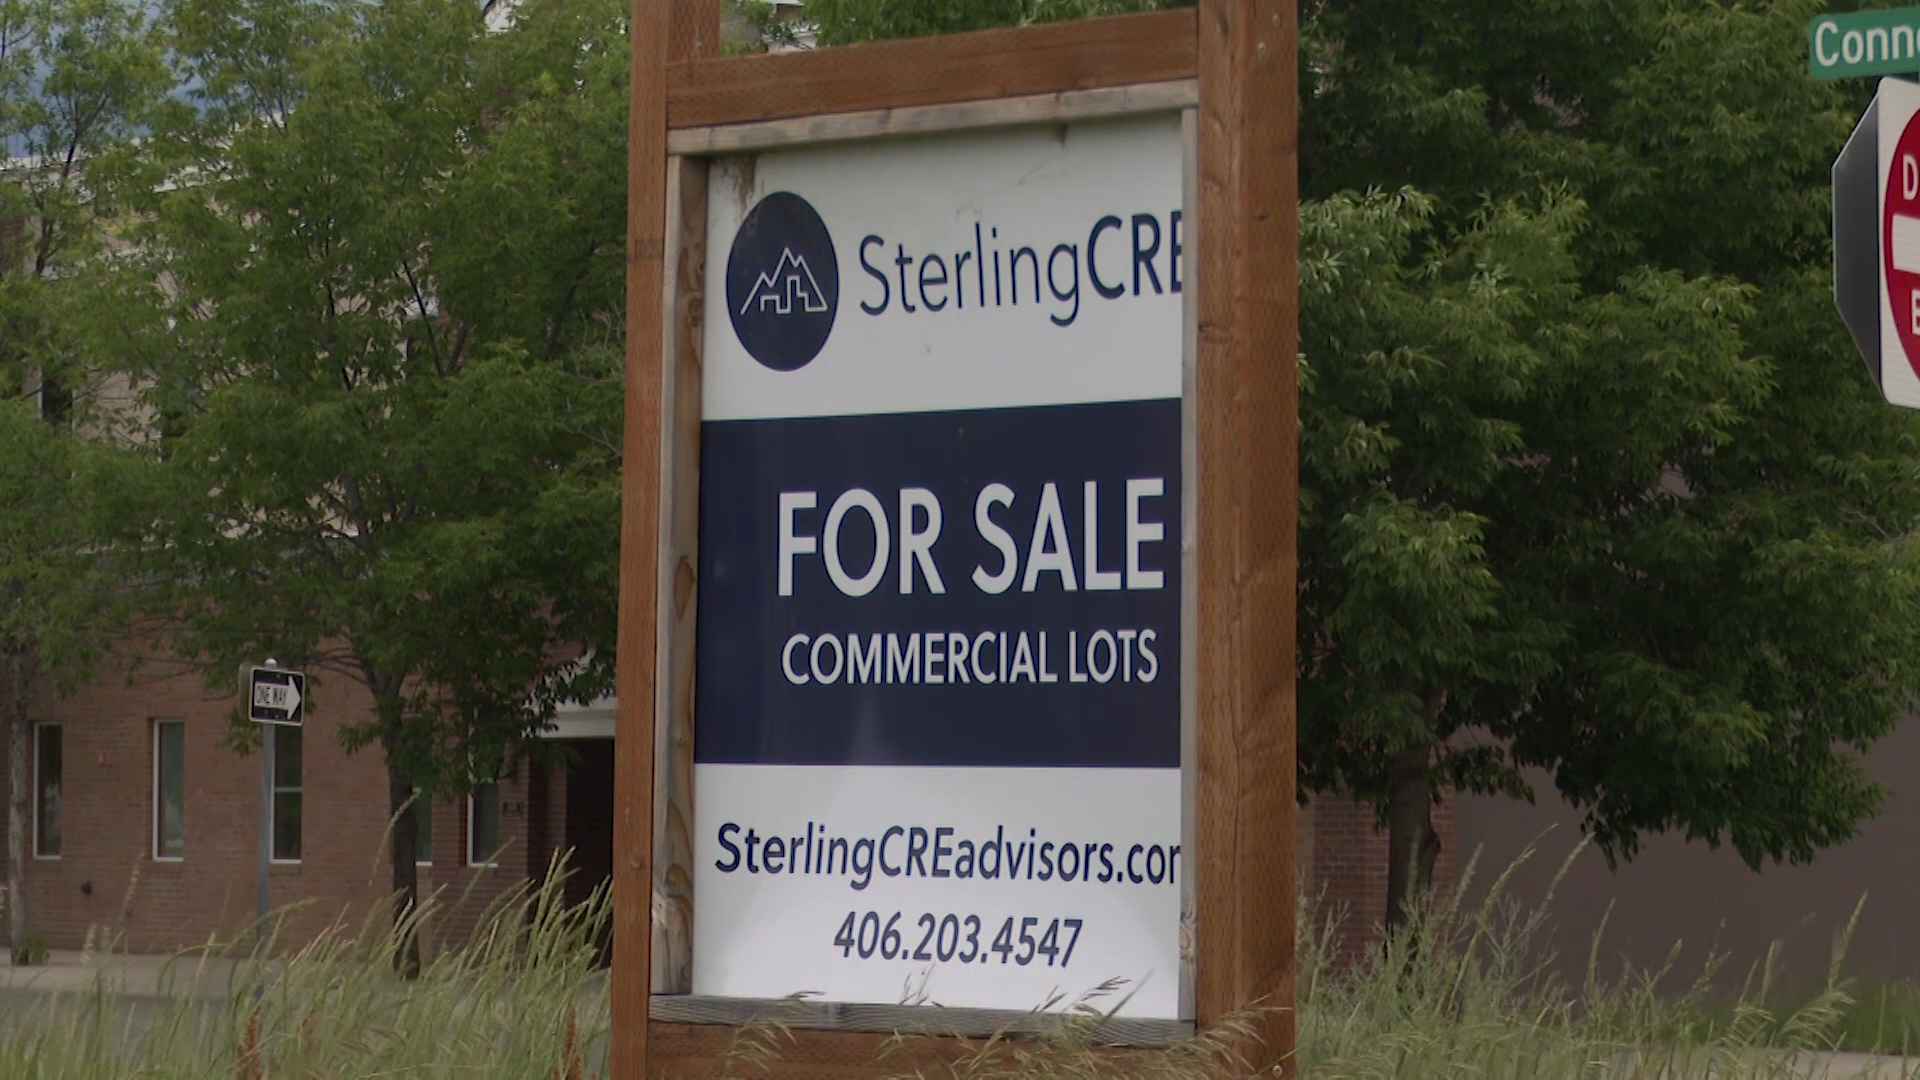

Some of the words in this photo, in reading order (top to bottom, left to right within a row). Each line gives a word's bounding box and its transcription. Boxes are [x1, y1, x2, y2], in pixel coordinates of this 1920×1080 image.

[1815, 21, 1920, 67] Conn
[778, 487, 947, 598] FOR
[971, 477, 1165, 595] SALE
[782, 630, 1058, 685] COMMERCIAL
[1068, 629, 1159, 684] LOTS
[256, 685, 270, 705] ONE
[272, 687, 288, 706] WAY
[833, 911, 1083, 968] 406.203.4547
